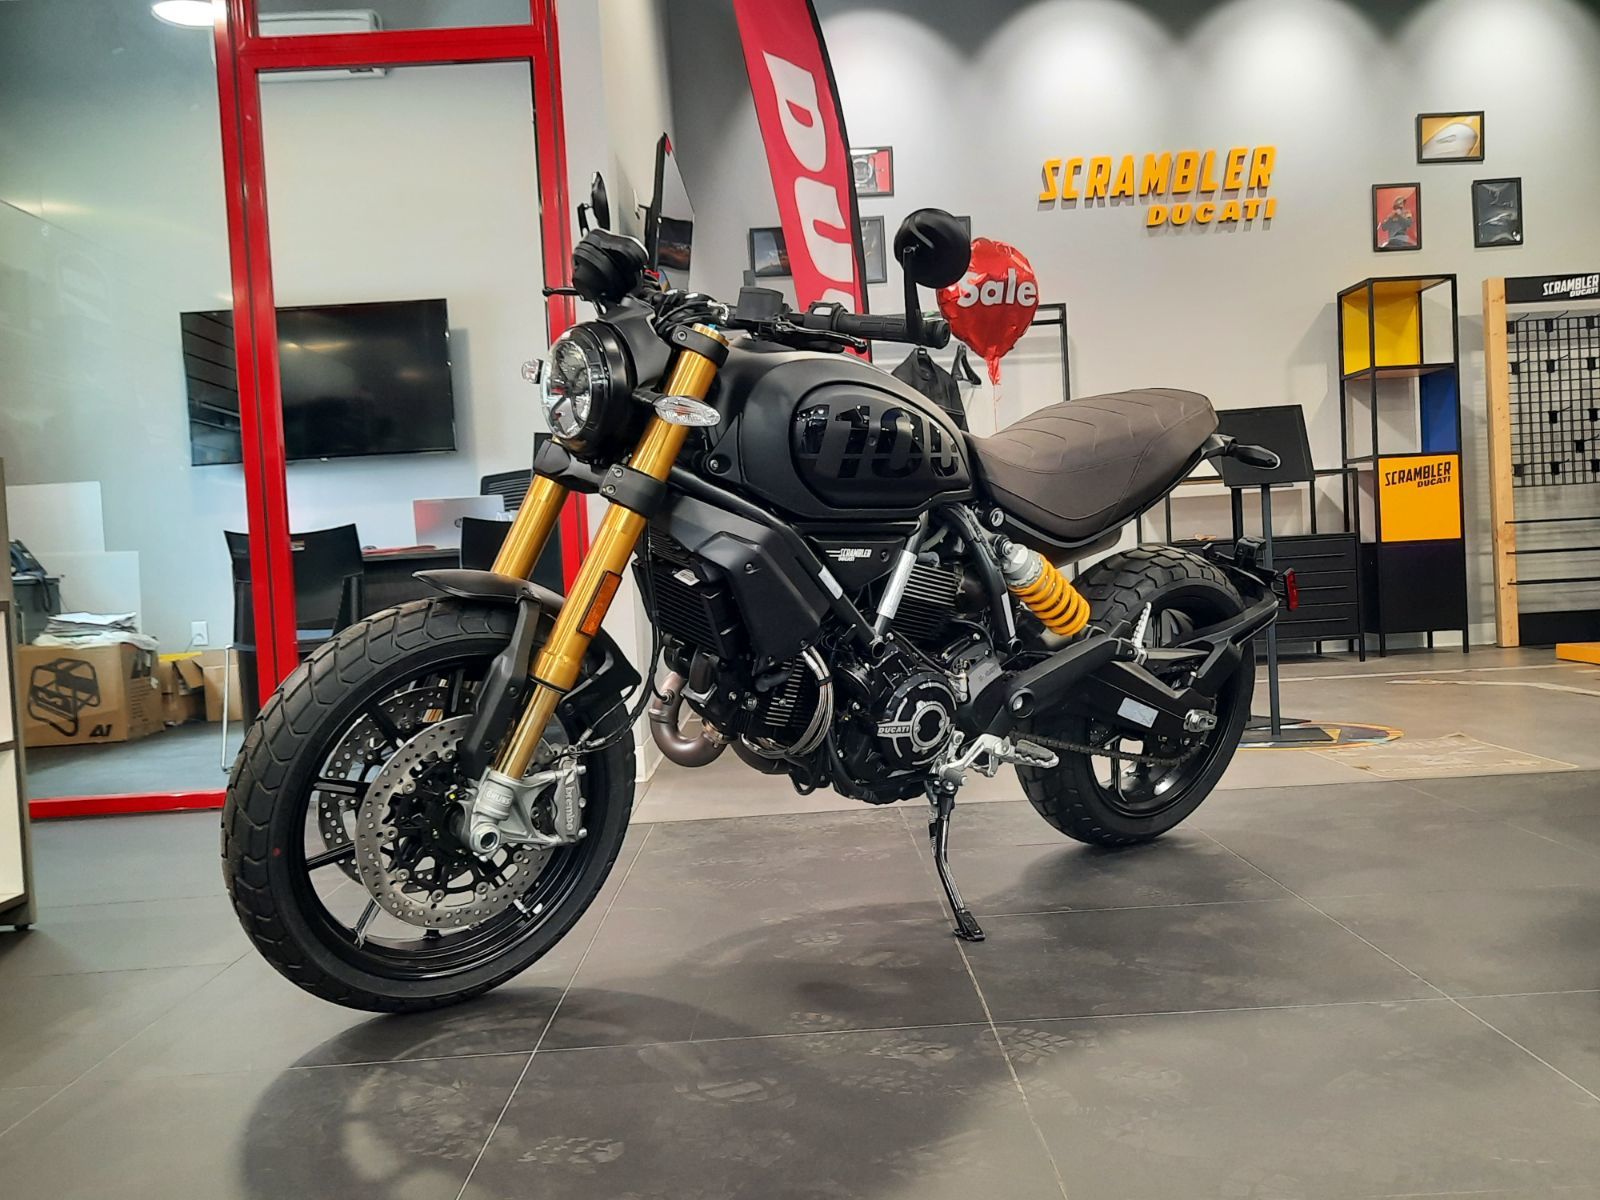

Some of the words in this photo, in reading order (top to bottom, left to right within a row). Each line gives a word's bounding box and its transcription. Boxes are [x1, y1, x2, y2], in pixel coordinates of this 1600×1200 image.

[1039, 146, 1277, 201] SCRAMBLER
[1146, 197, 1277, 228] DUCATI
[956, 268, 1037, 308] Sale
[1542, 274, 1600, 296] SCRAMBLER
[1569, 286, 1599, 298] DUCATI
[1384, 461, 1452, 487] SCRAMBLER
[1417, 475, 1452, 488] DUCATI
[878, 726, 910, 734] DUCATI
[565, 786, 576, 831] brembo
